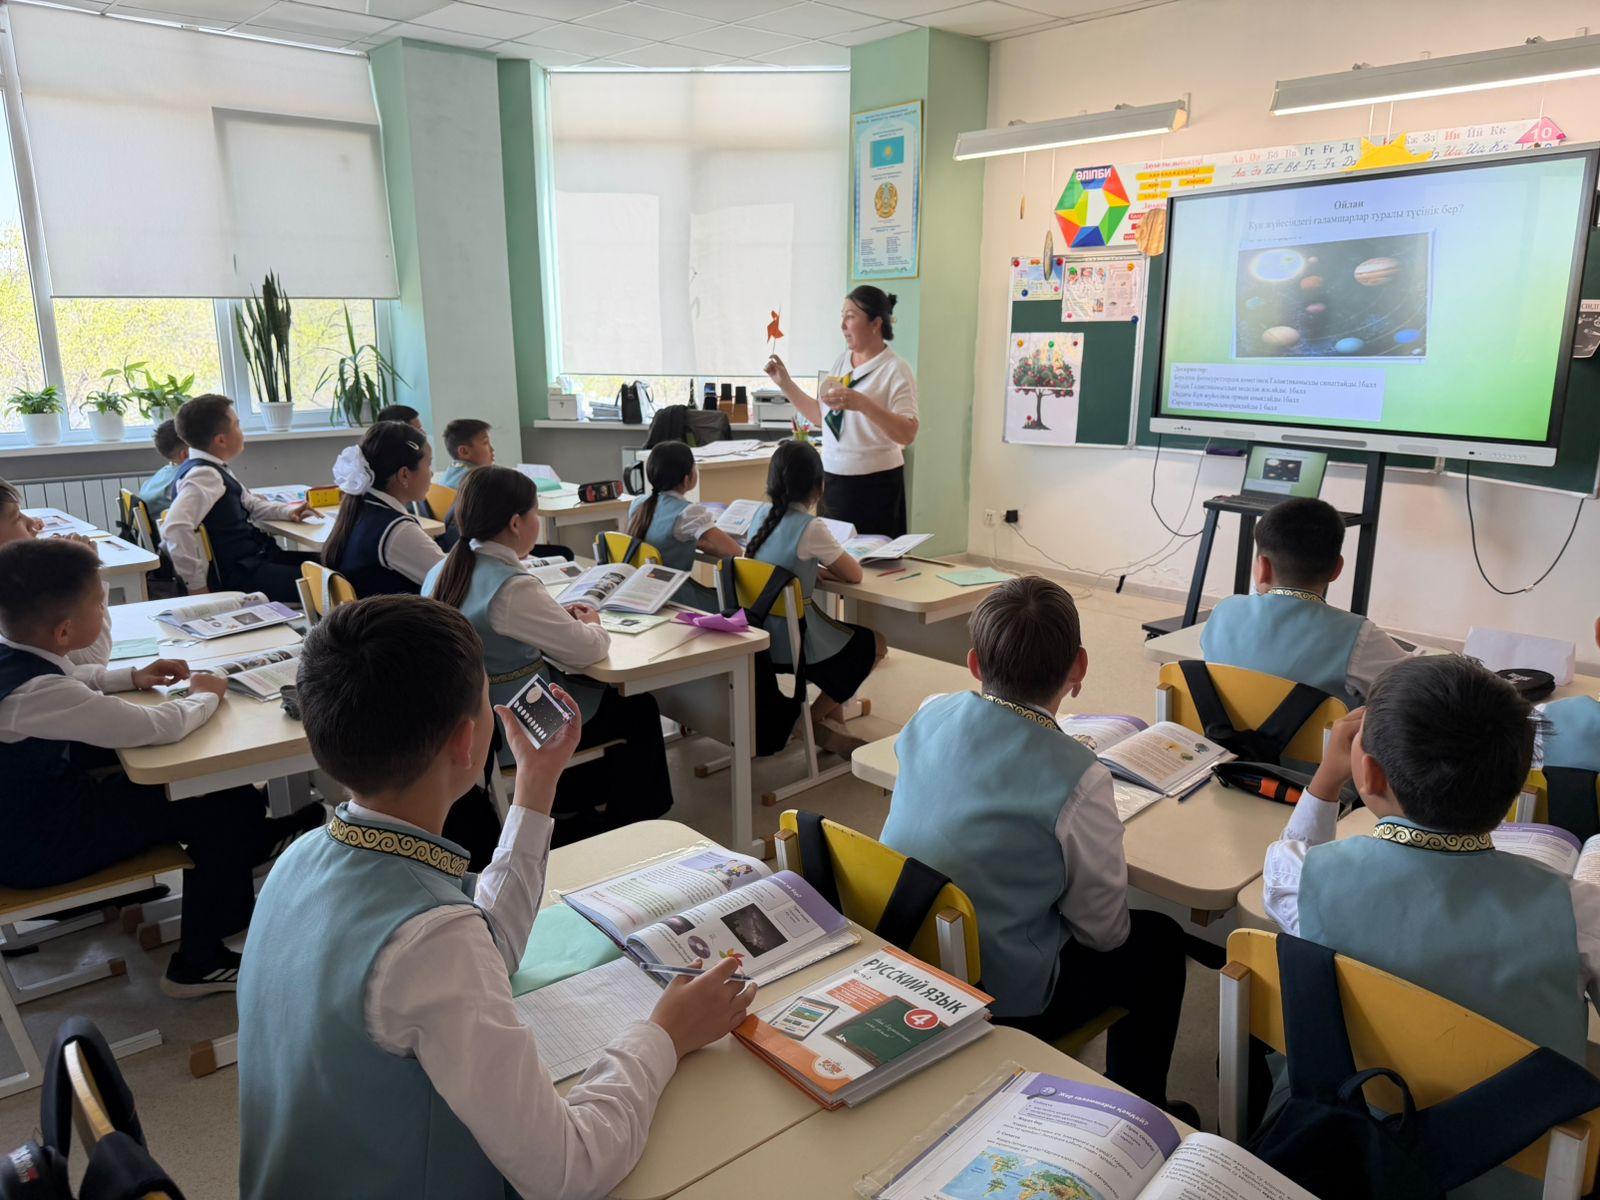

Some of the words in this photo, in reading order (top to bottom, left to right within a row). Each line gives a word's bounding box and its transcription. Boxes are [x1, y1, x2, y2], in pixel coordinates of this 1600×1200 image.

[1490, 125, 1507, 136] Кк
[1076, 167, 1112, 181] ӘЛІПБИ
[1333, 199, 1365, 210] Ойлан
[1371, 209, 1404, 223] туралы
[1406, 207, 1440, 221] түсінік
[1441, 203, 1465, 216] бер?
[863, 958, 930, 993] РУССКИЙ
[919, 987, 968, 1015] ЯЗЫК
[910, 1014, 934, 1025] 4
[1058, 1091, 1074, 1101] Жер
[1116, 1107, 1149, 1127] қандай?
